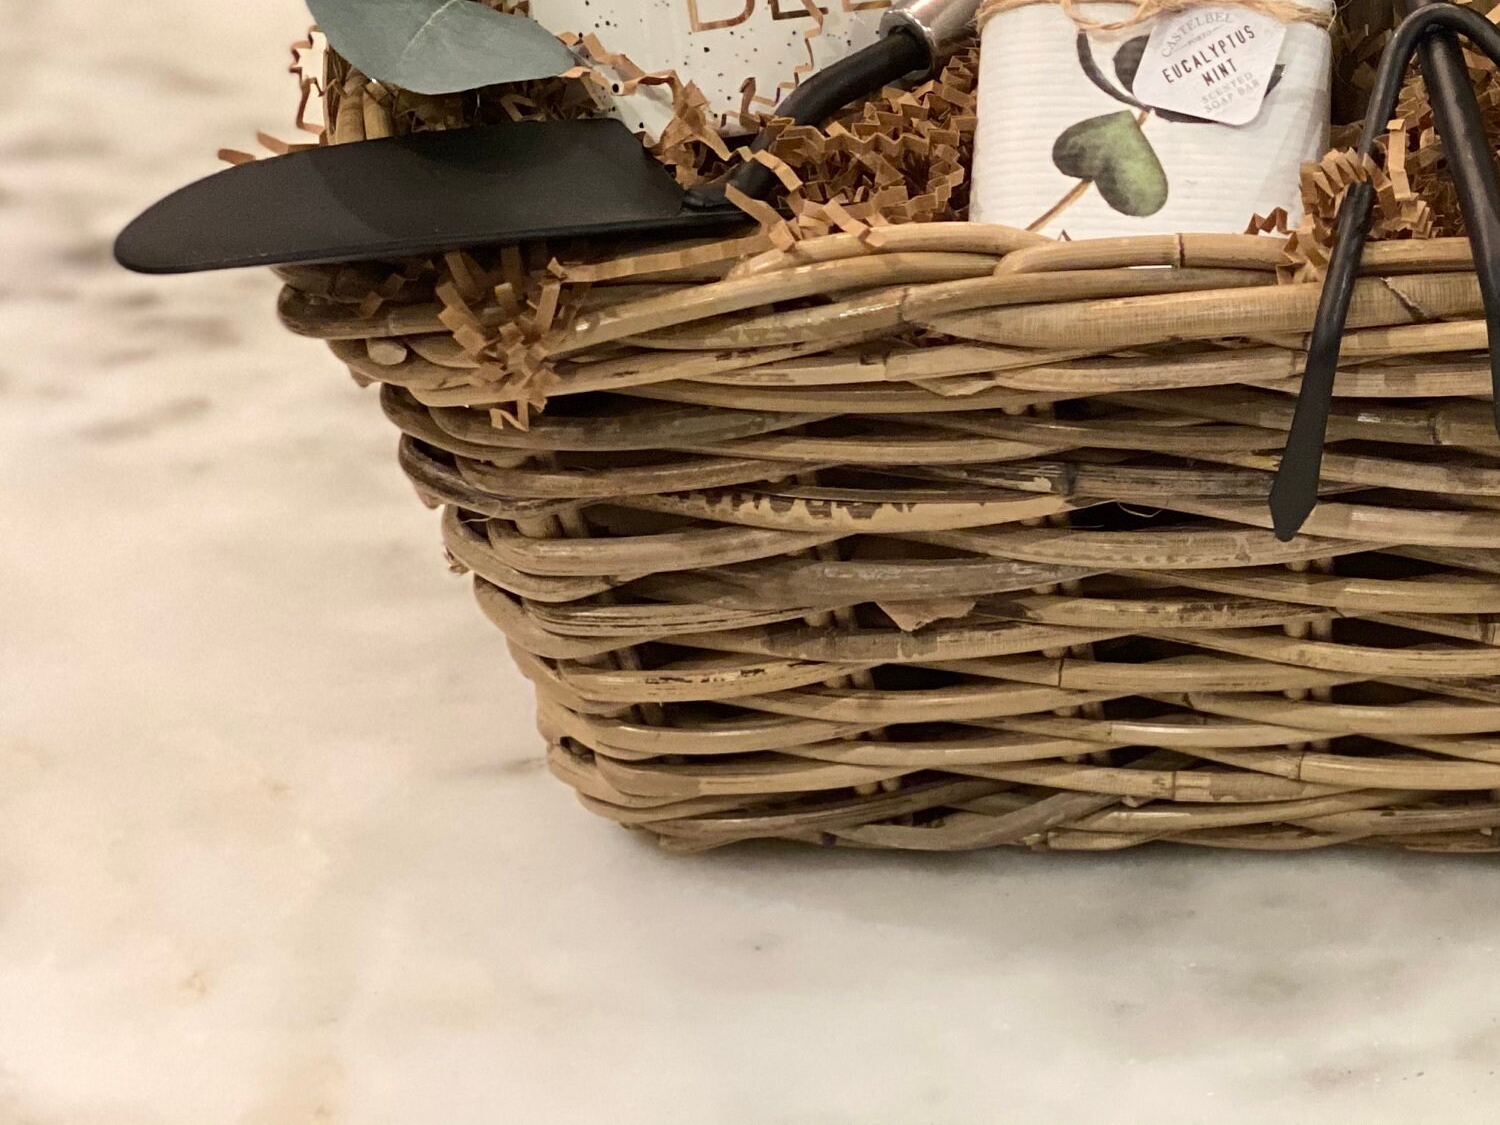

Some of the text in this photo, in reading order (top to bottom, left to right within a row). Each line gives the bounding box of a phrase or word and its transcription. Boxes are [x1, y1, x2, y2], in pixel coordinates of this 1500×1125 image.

[1162, 11, 1235, 58] CASTELBEL
[1162, 25, 1256, 83] EUCALYPTUS
[1201, 58, 1238, 87] MINT
[1201, 72, 1253, 104] SCENTED
[1205, 78, 1261, 114] SOAP BAR
